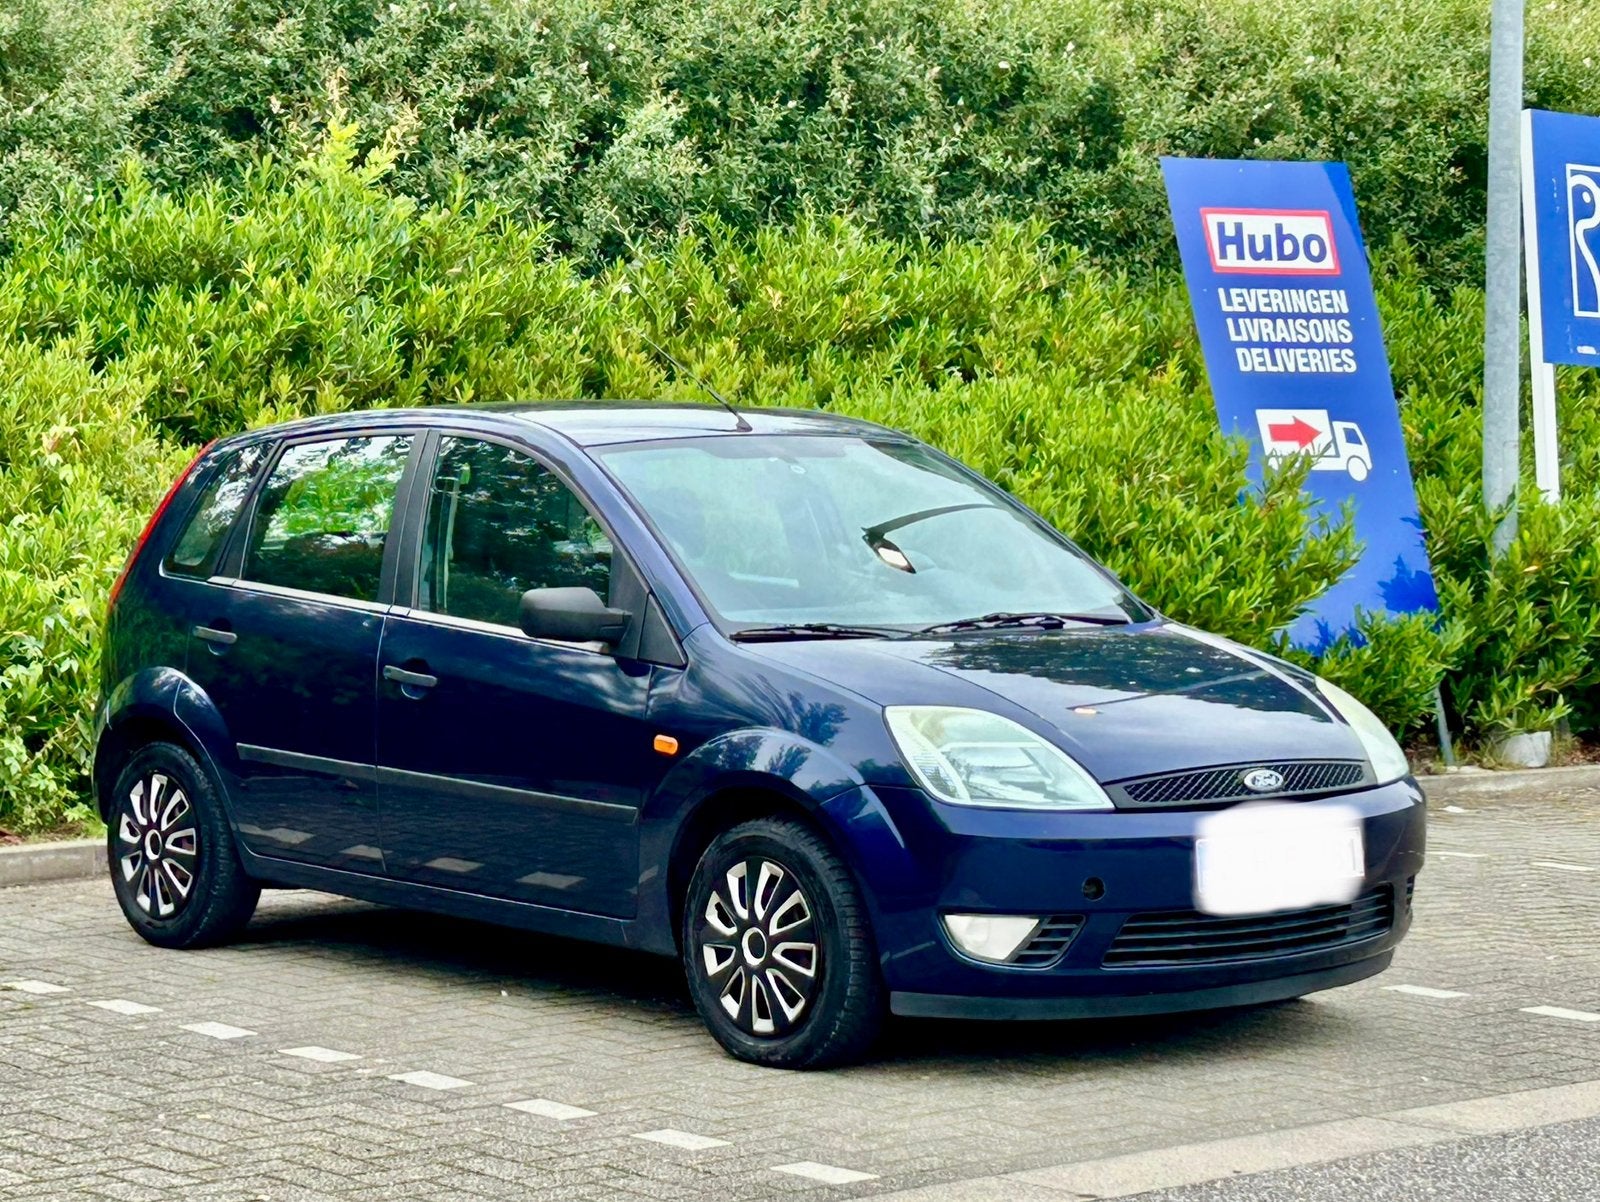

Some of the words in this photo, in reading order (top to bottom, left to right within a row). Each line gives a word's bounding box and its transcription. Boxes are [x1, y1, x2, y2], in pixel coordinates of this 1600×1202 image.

[1217, 221, 1327, 263] Hubo
[1218, 287, 1349, 313] LEVERINGEN
[1226, 317, 1353, 343] LIVRAISONS
[1236, 347, 1358, 373] DELIVERIES
